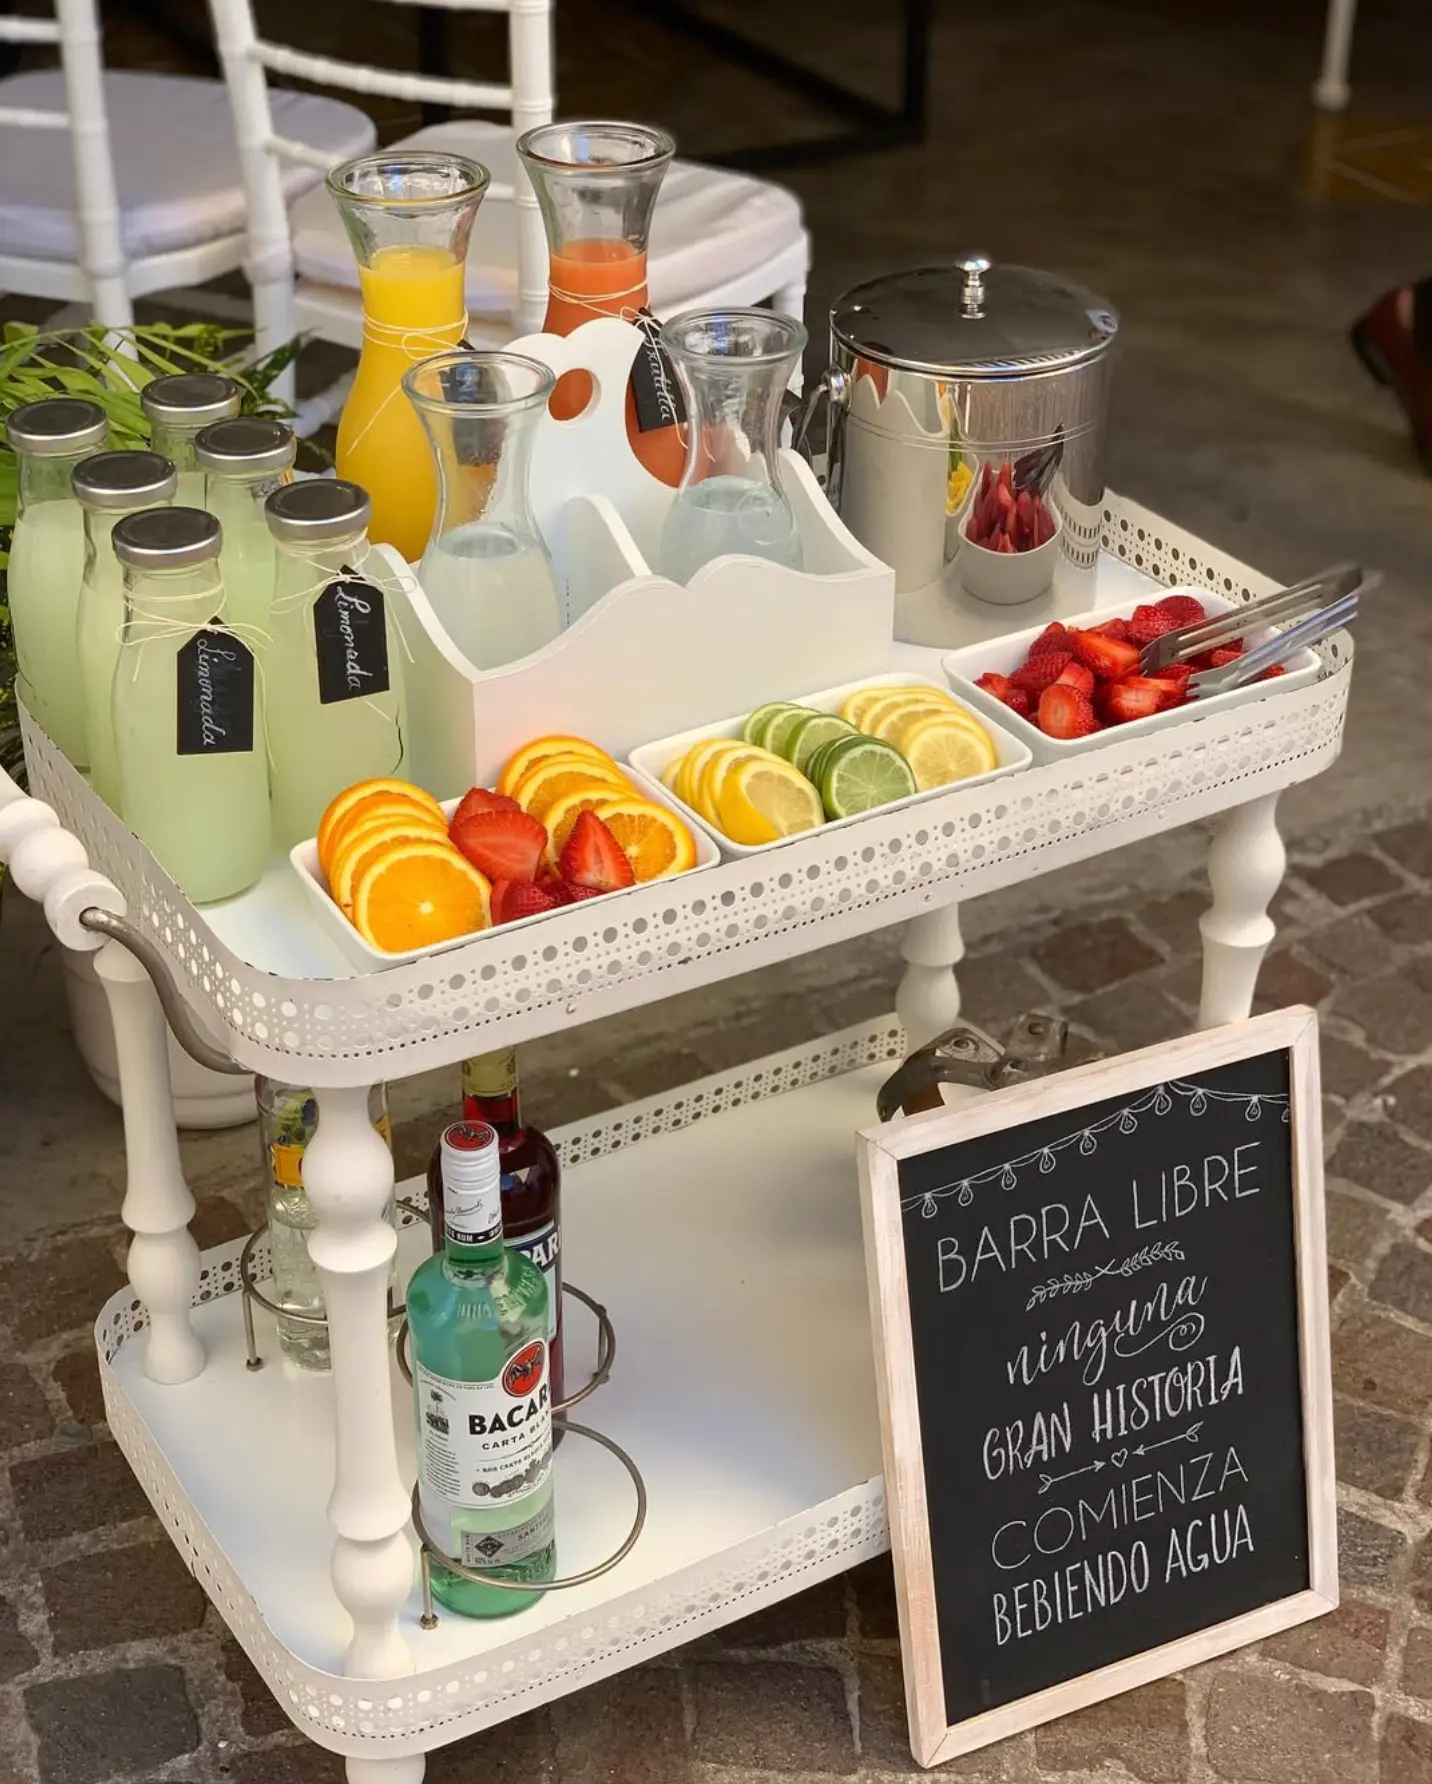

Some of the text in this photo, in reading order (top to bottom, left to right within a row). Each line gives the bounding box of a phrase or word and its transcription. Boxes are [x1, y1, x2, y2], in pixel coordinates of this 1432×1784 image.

[195, 638, 237, 747] Limonada
[335, 586, 373, 690] Limonada
[936, 1141, 1262, 1293] BARRA LIBRE
[1006, 1276, 1208, 1385] ninguna
[482, 1433, 526, 1450] CARTA
[983, 1346, 1244, 1480] GRAN HISTORIA
[992, 1445, 1248, 1570] COMIENZA
[993, 1504, 1254, 1645] BEBIENDO AGUA
